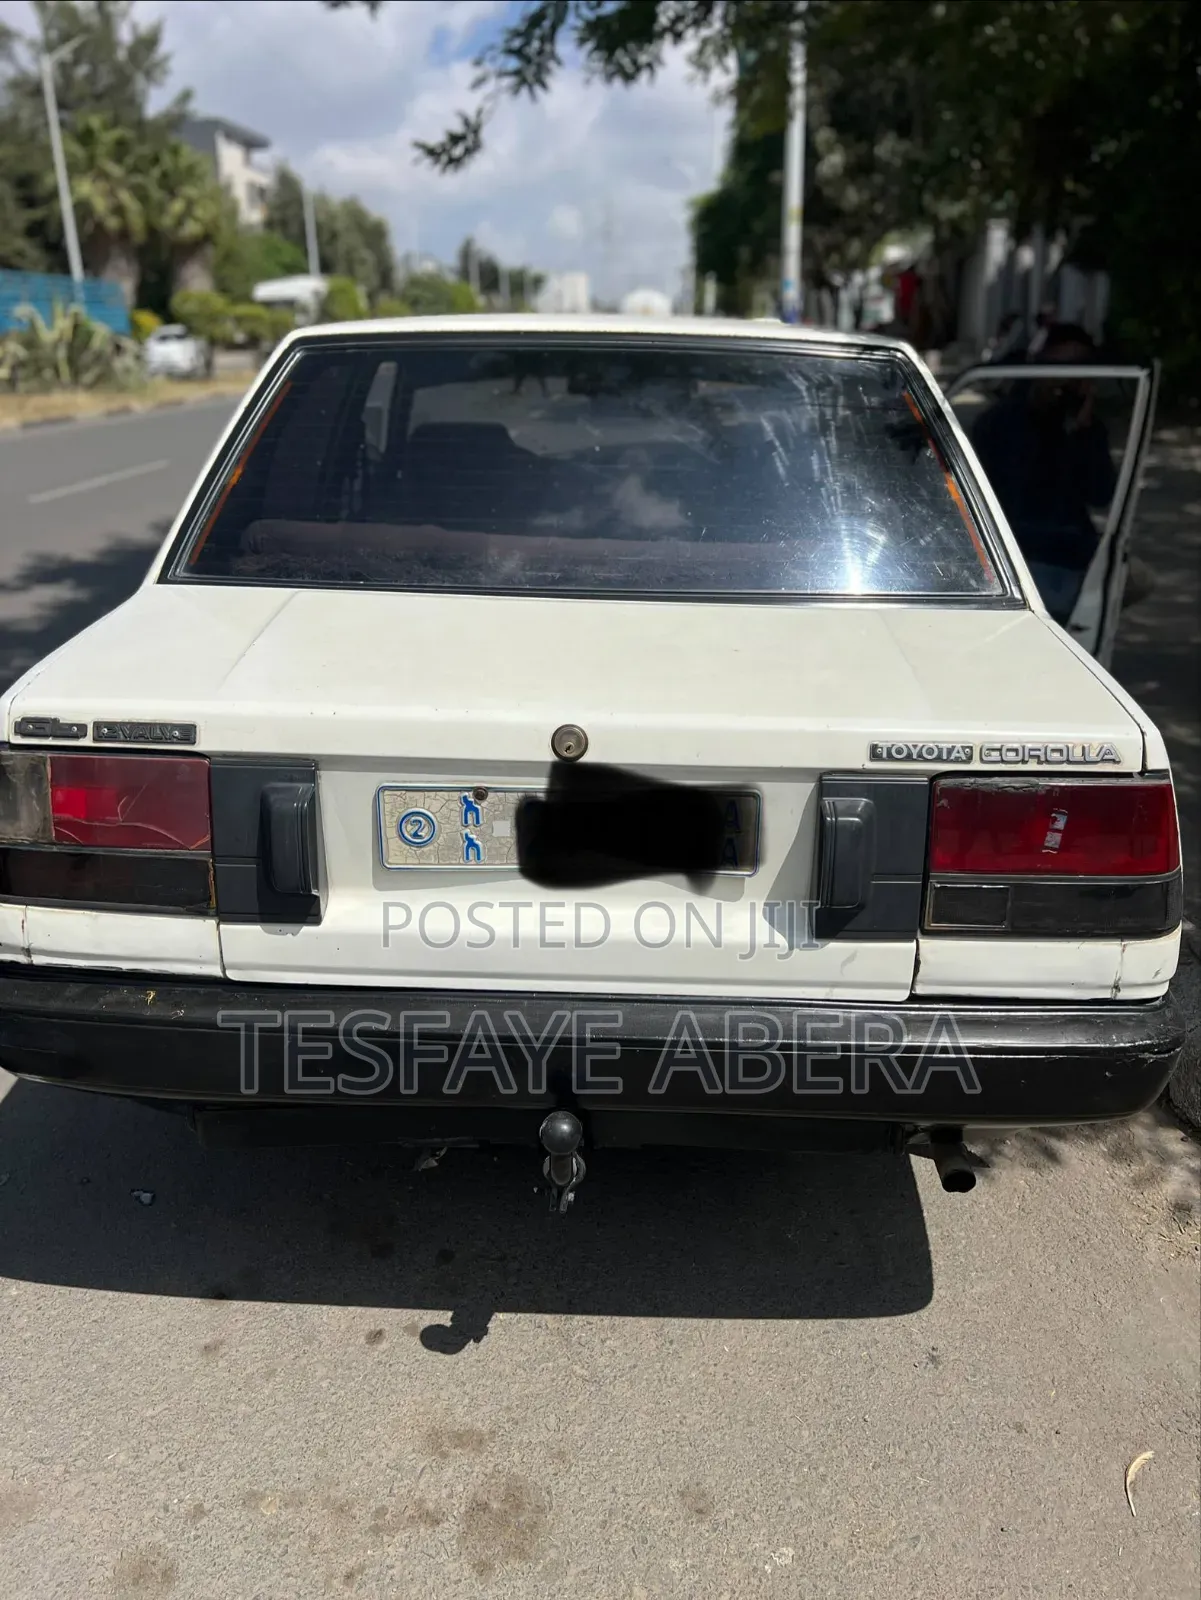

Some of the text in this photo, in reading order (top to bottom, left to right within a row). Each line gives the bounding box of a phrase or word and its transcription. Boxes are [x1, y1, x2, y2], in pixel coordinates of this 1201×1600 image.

[879, 742, 1122, 765] TOYOTA COROLLA
[409, 817, 424, 839] 2
